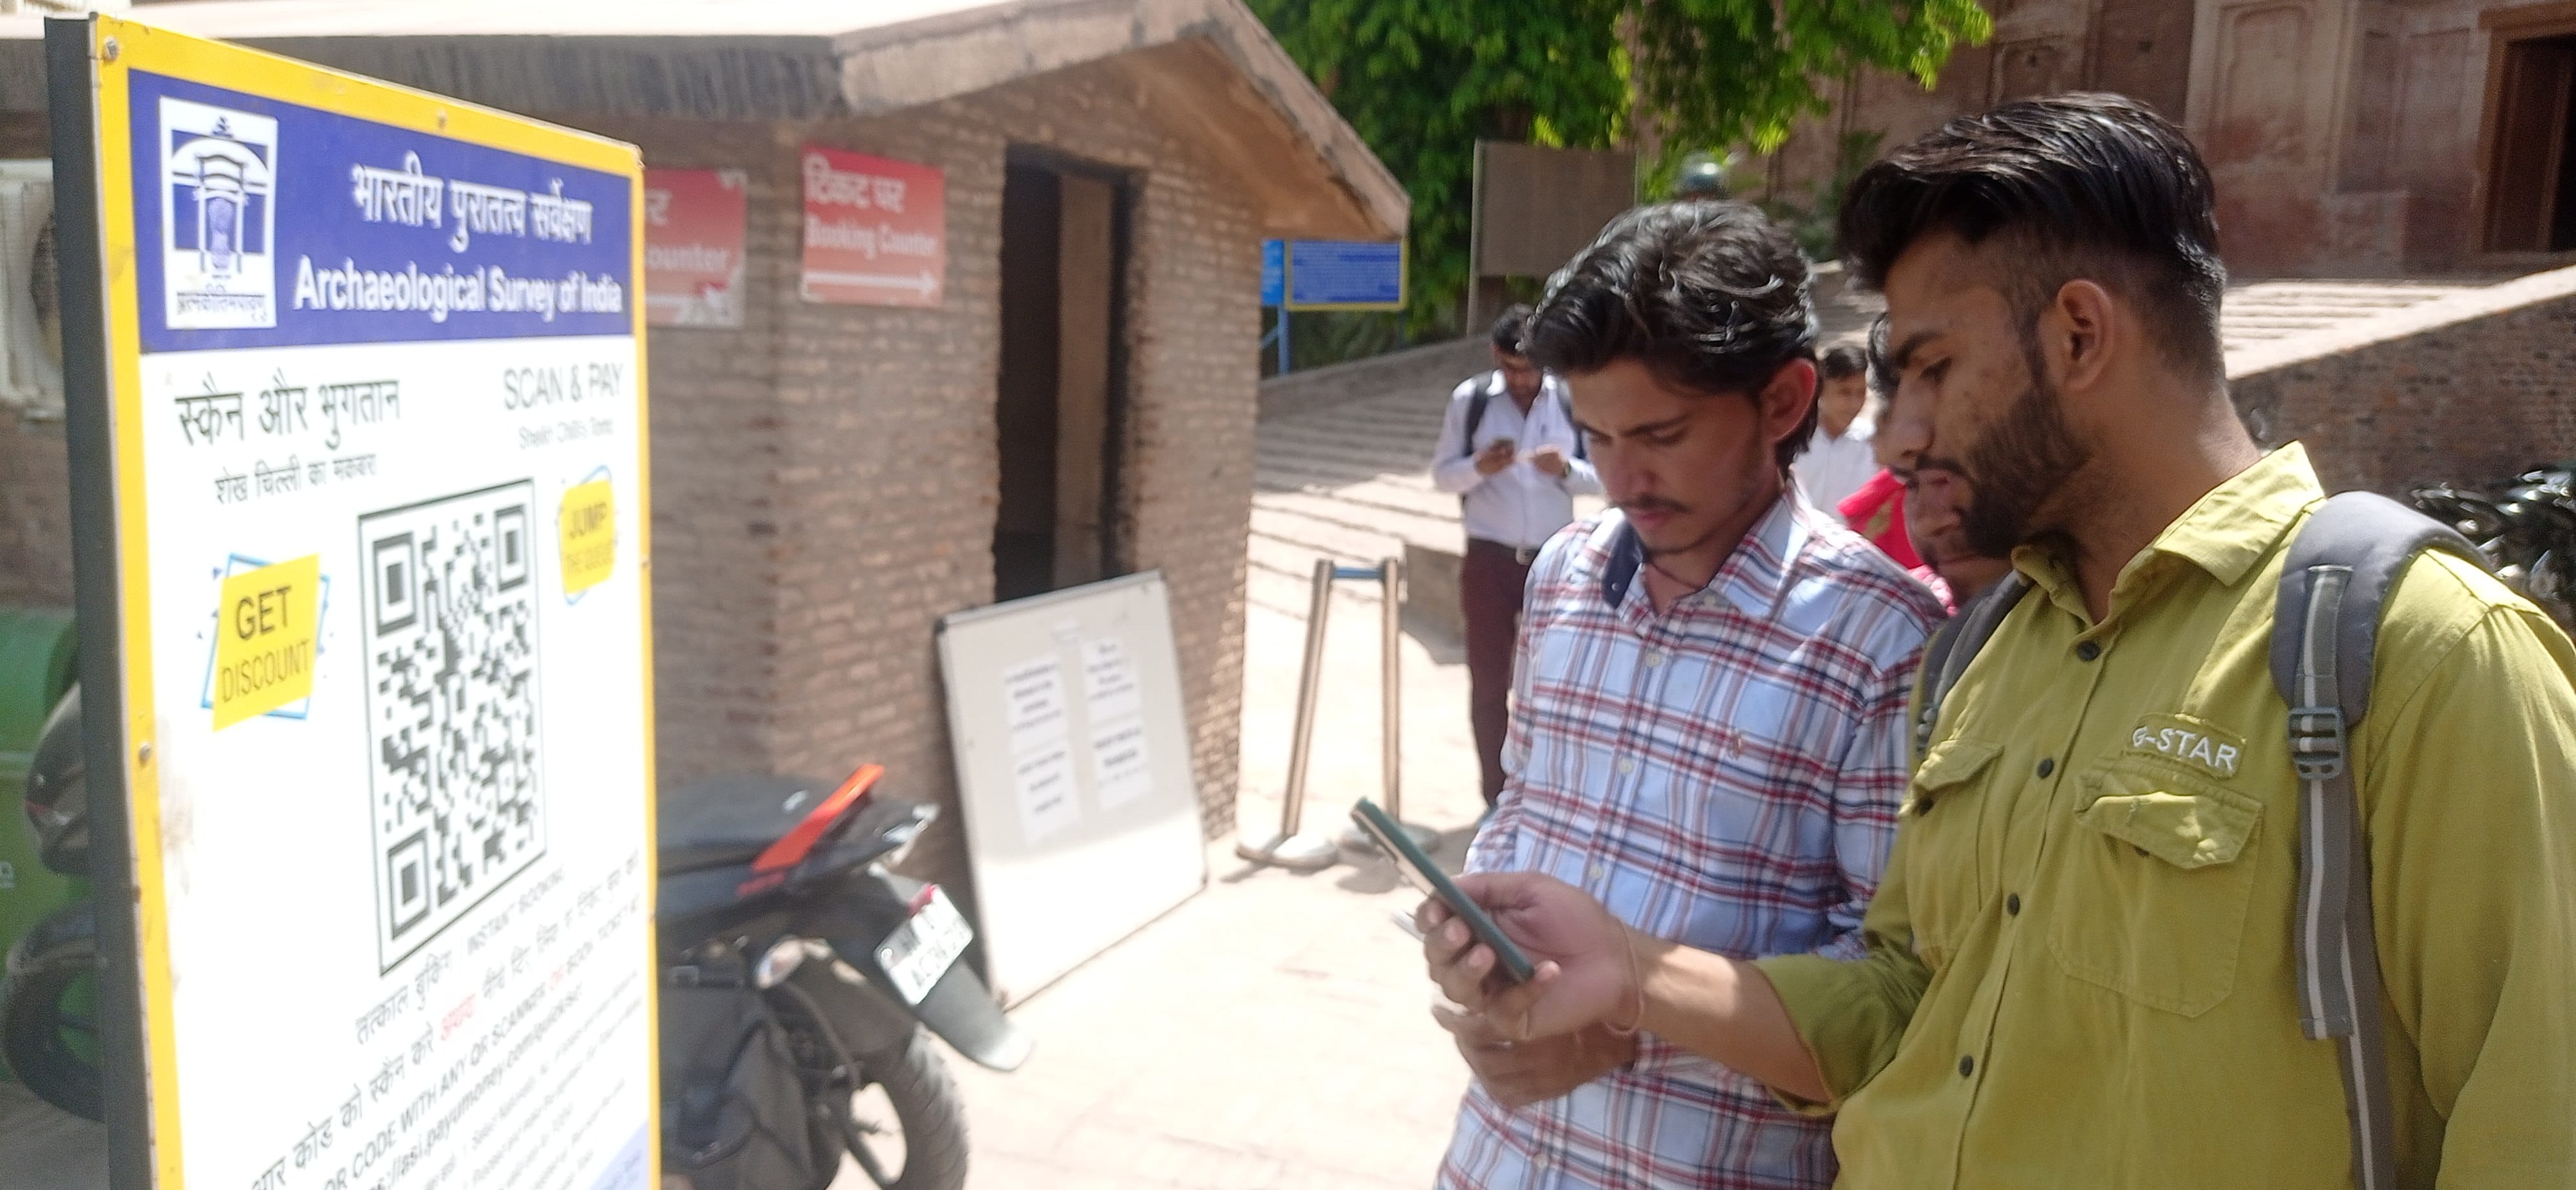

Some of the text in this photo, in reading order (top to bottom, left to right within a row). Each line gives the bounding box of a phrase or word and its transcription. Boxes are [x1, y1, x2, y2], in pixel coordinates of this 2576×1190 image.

[352, 149, 444, 228] भारतीय
[528, 177, 593, 244] सर्वेक्षण
[645, 244, 728, 274] ounter
[806, 212, 937, 261] Booking Counter
[293, 254, 623, 323] Archaeological Survey of India
[173, 367, 400, 451] स्कैन और भुगतान
[503, 361, 624, 411] SCAN & PAY
[214, 466, 248, 504] शेख
[254, 453, 301, 499] चिल्ली
[307, 462, 327, 486] का
[236, 585, 292, 640] GET
[222, 639, 309, 703] DISCOUNT
[2132, 726, 2237, 774] G-STAR
[355, 984, 408, 1045] तत्काल
[292, 1115, 334, 1169] कोड
[339, 1083, 363, 1129] को
[351, 1120, 398, 1180] CODE
[399, 1083, 437, 1133] WITH
[440, 1052, 467, 1098] ANY
